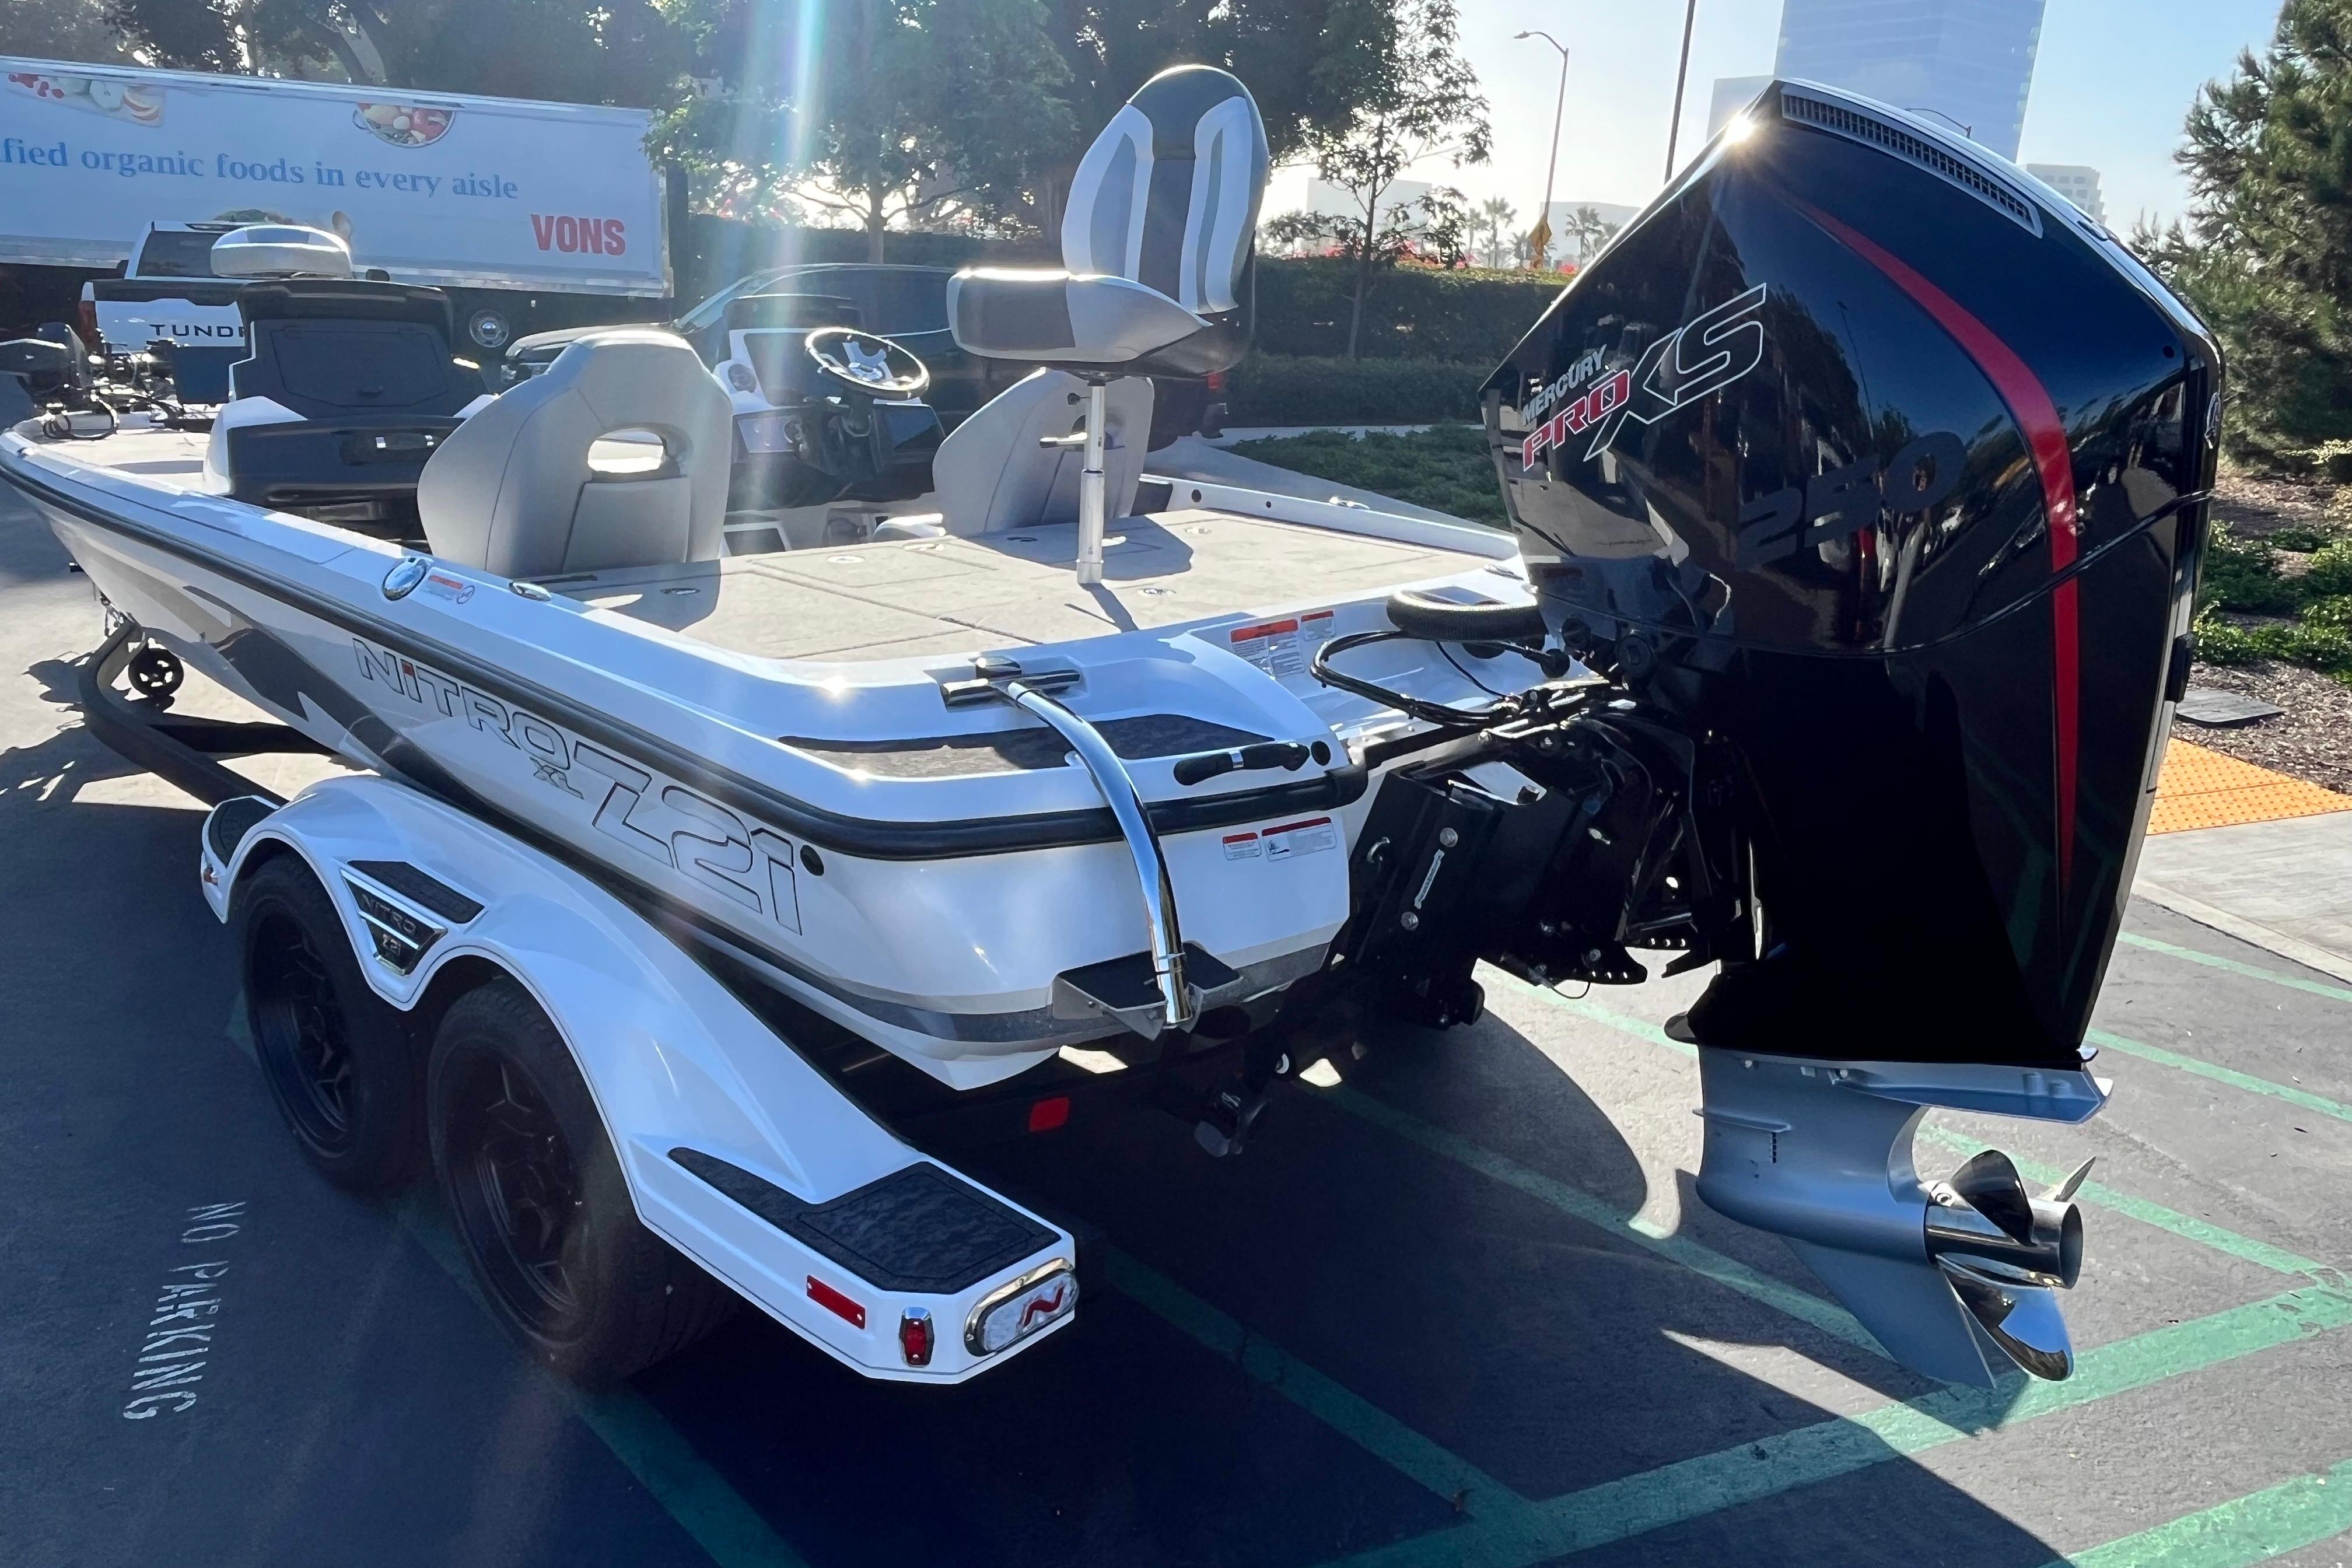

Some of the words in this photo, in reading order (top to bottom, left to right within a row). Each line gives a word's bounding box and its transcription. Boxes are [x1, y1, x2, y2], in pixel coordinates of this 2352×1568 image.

[0, 138, 68, 167] fied
[81, 150, 204, 177] organic
[216, 153, 304, 184] foods
[316, 160, 345, 186] in
[355, 169, 443, 198] every
[452, 172, 519, 200] aisle
[530, 214, 626, 256] VONS
[1521, 344, 1607, 426] MERCURY
[1734, 431, 1968, 570] 250
[352, 638, 570, 770] NITRO
[573, 740, 802, 936] Z21
[362, 893, 416, 936] NITRO
[180, 1201, 247, 1243] NO
[123, 1260, 230, 1420] PARKING
